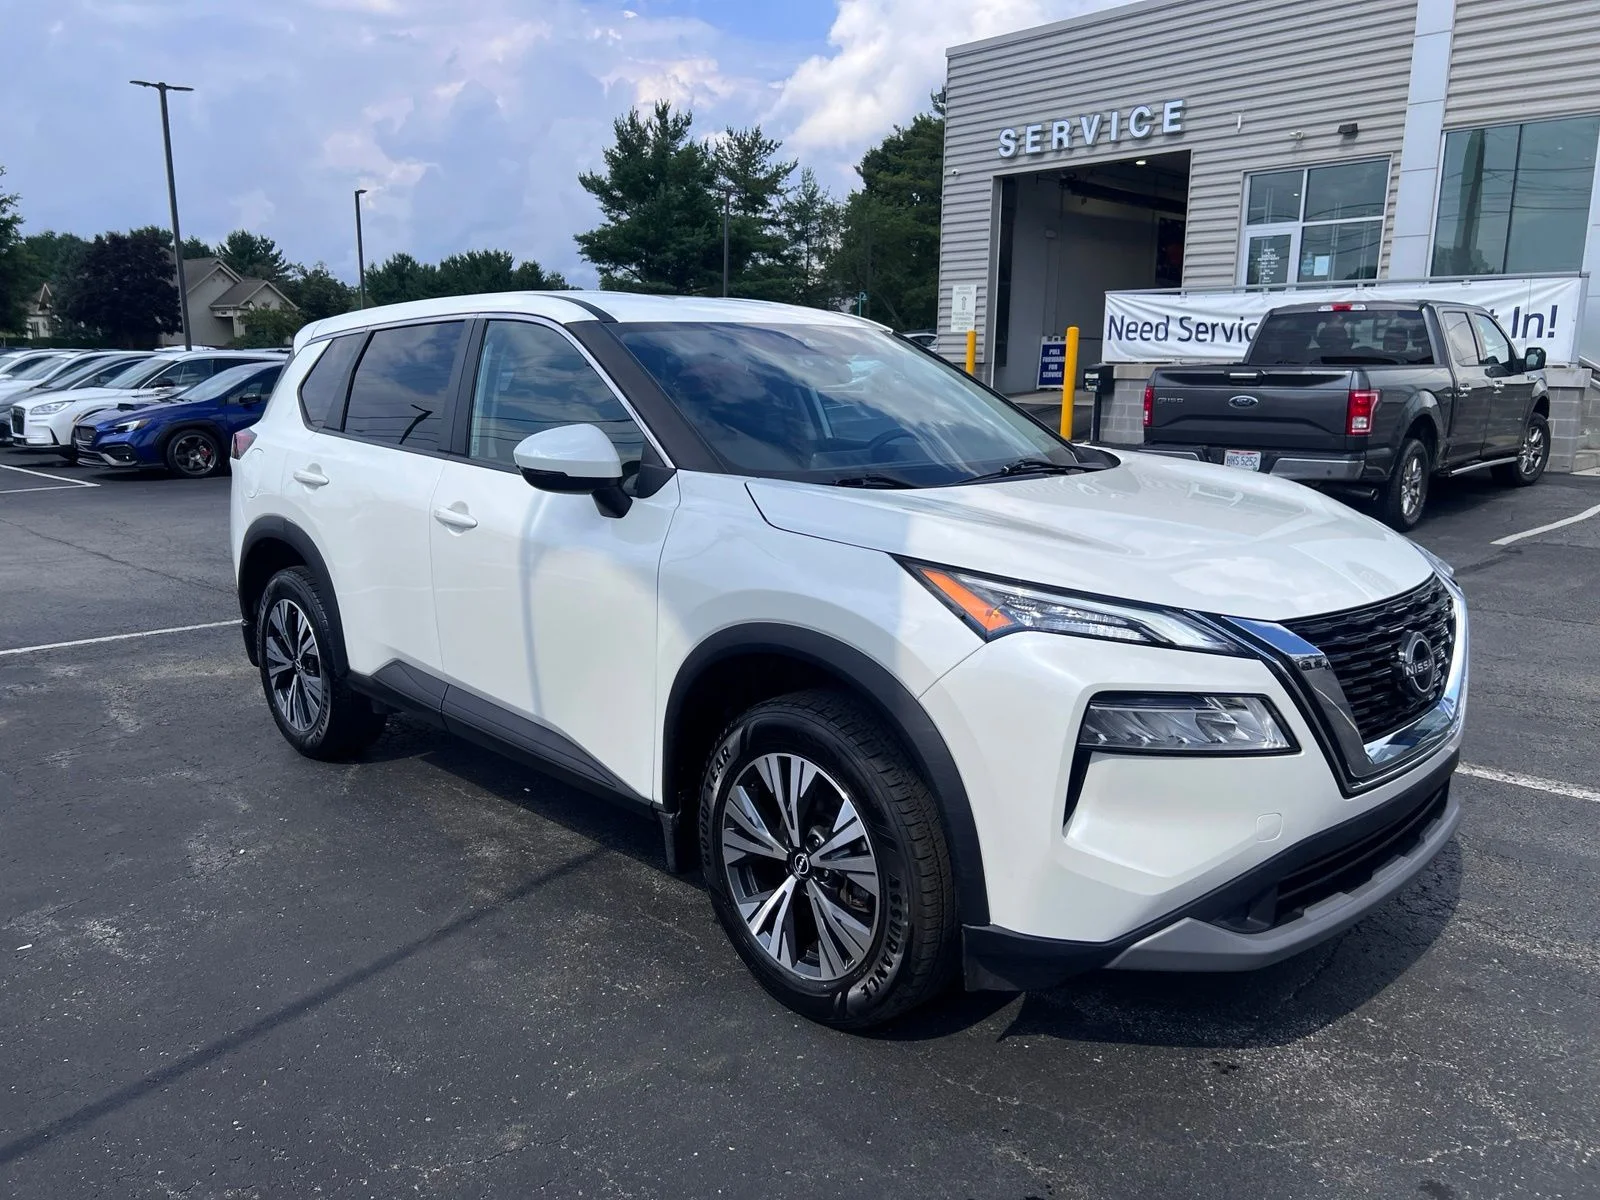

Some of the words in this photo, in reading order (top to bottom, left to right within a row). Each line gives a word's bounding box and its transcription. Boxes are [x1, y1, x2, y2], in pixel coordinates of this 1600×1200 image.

[998, 99, 1184, 157] SERVICE
[1107, 314, 1170, 342] Need
[1177, 316, 1258, 342] Servic
[1511, 304, 1558, 339] In!
[1241, 455, 1258, 467] 5252
[1405, 658, 1434, 676] NISSA
[860, 872, 903, 1001] ASSURANCE
